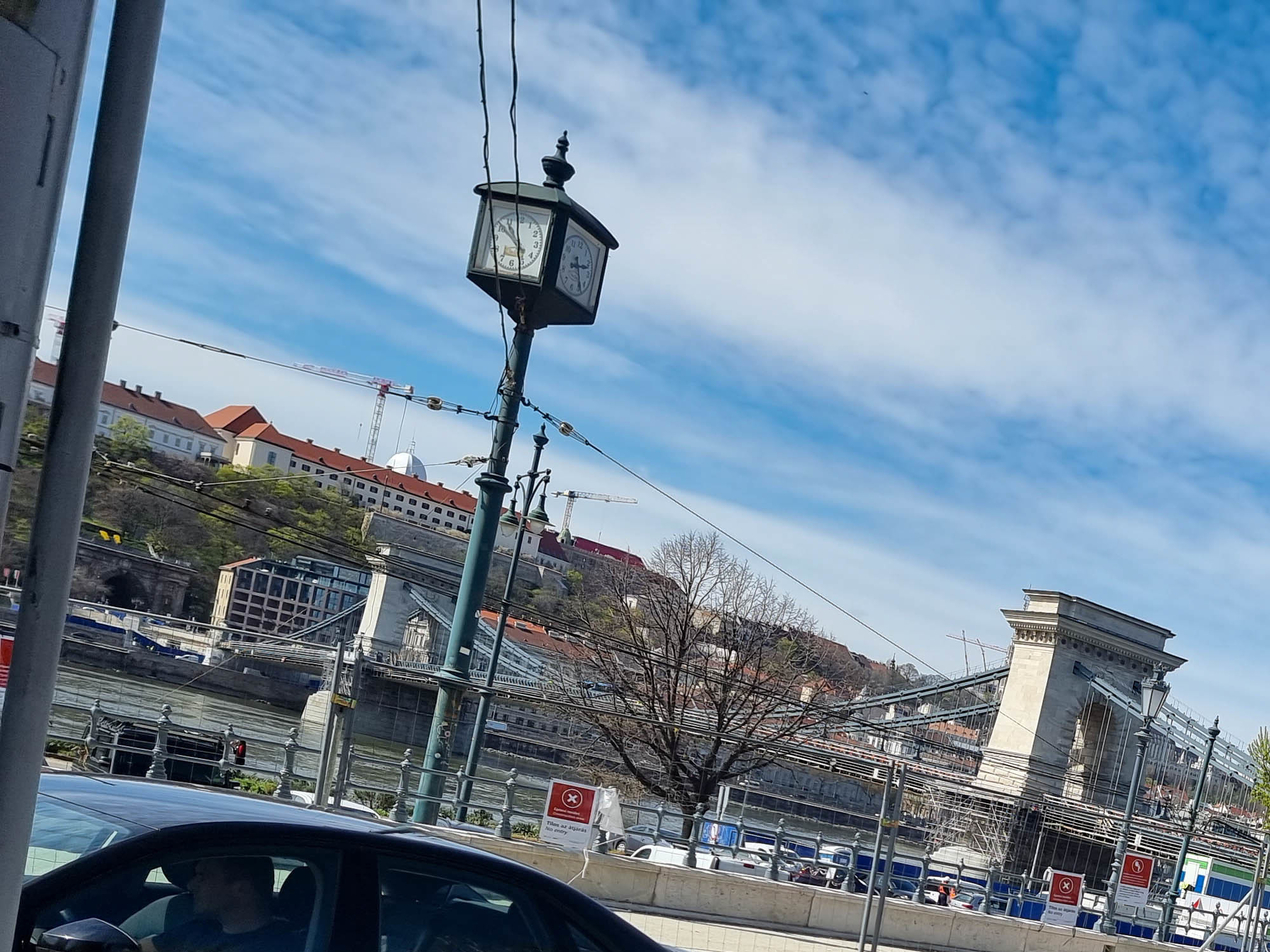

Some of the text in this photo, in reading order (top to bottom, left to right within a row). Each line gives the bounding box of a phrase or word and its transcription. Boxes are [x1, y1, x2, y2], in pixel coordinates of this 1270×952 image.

[532, 230, 539, 238] 2
[533, 241, 539, 249] 3
[528, 251, 534, 259] 4
[509, 259, 515, 267] 6
